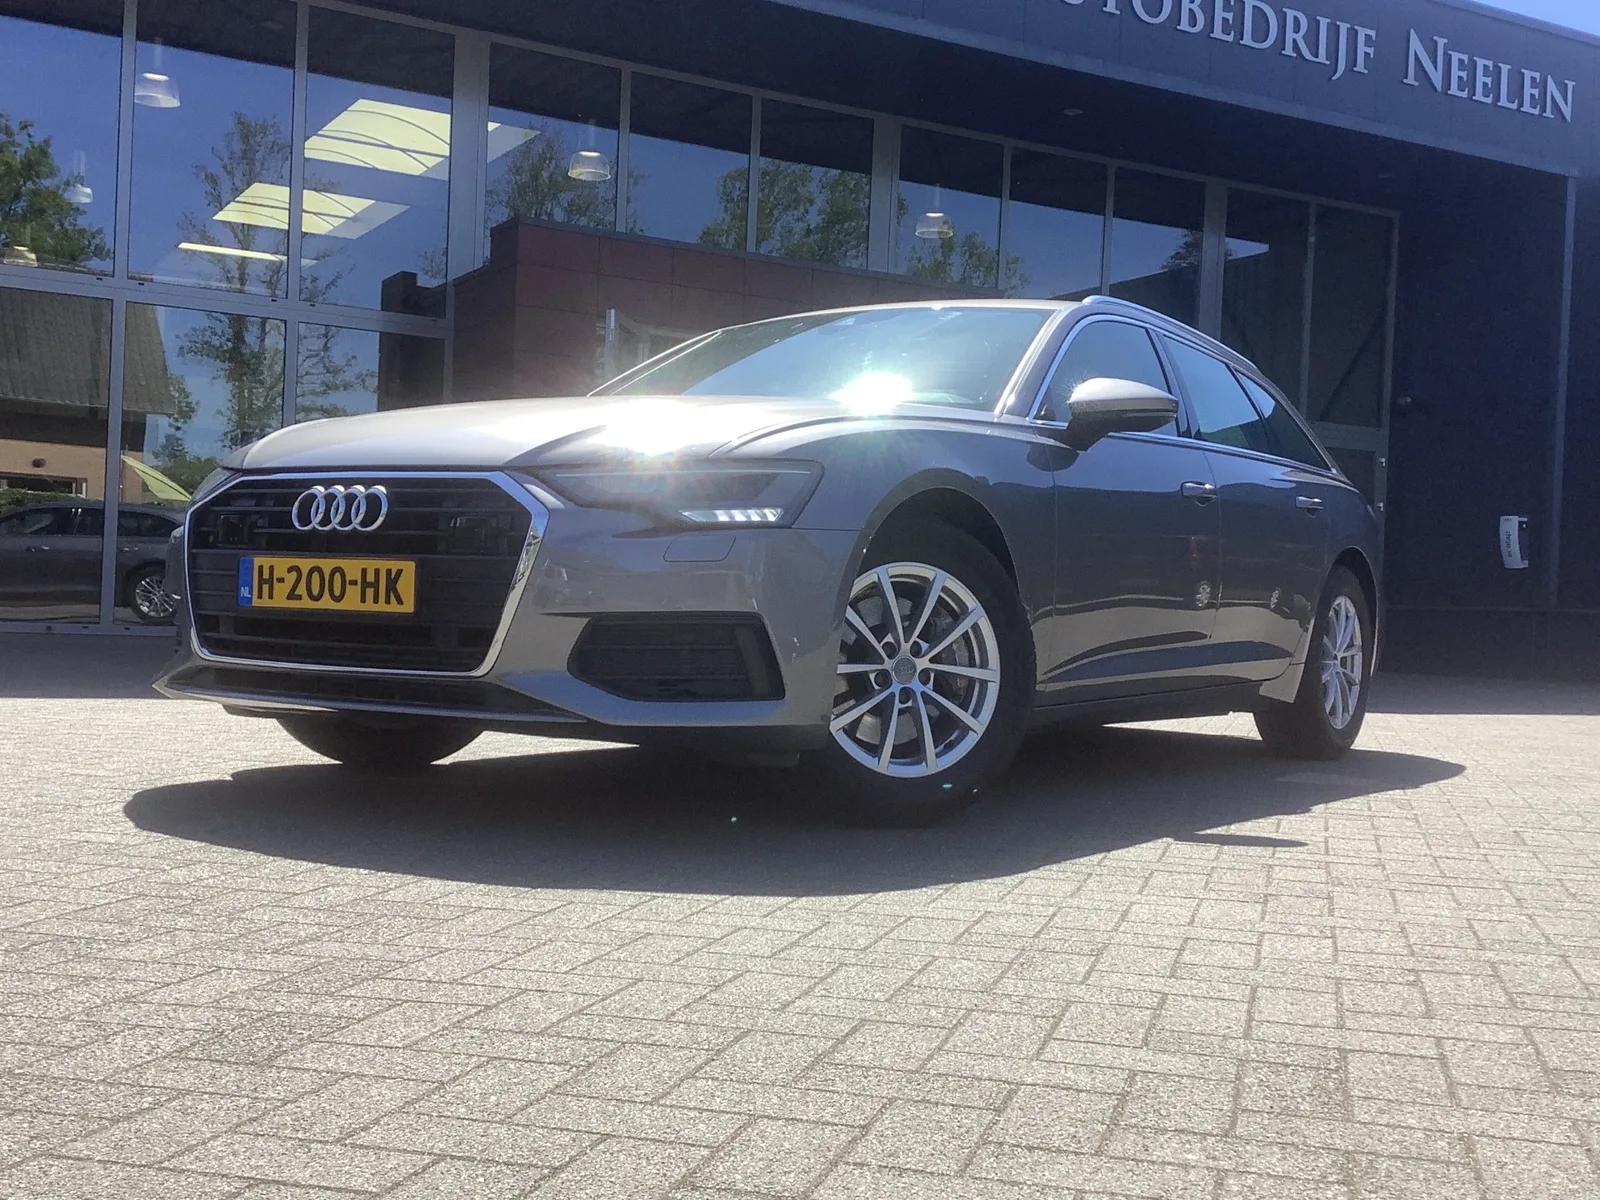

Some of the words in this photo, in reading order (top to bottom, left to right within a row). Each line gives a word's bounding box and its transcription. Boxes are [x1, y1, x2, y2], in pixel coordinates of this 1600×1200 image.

[1064, 0, 1377, 80] OBEDRIJF
[1402, 28, 1576, 122] NEELEN
[240, 586, 251, 598] NL
[257, 564, 404, 606] H-200-HK
